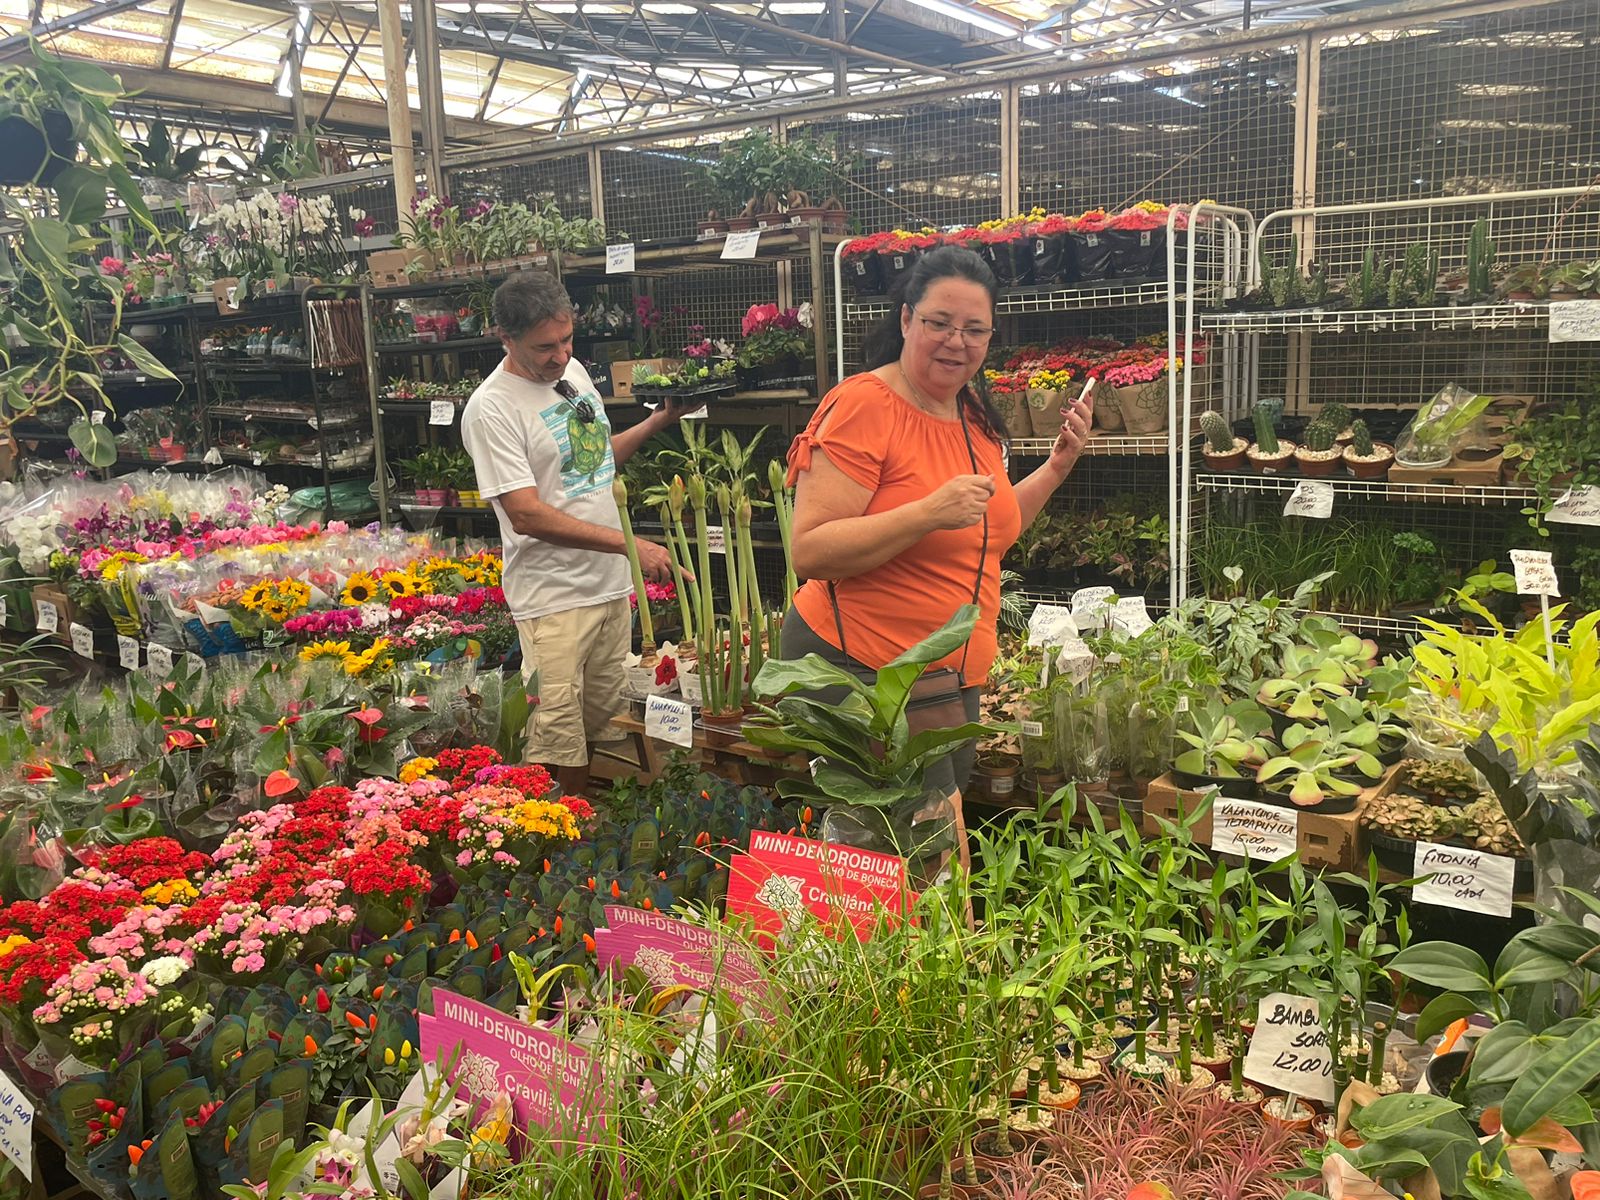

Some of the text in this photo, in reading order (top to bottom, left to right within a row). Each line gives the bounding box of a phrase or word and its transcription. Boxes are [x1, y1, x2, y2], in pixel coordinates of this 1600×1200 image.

[753, 835, 900, 878] MINI-DENDROBIUM
[846, 869, 860, 881] DE
[861, 873, 899, 890] BONECA
[444, 1001, 591, 1079] MINI-DENDROBIUM
[510, 1048, 537, 1068] OLHO
[539, 1060, 553, 1076] DE
